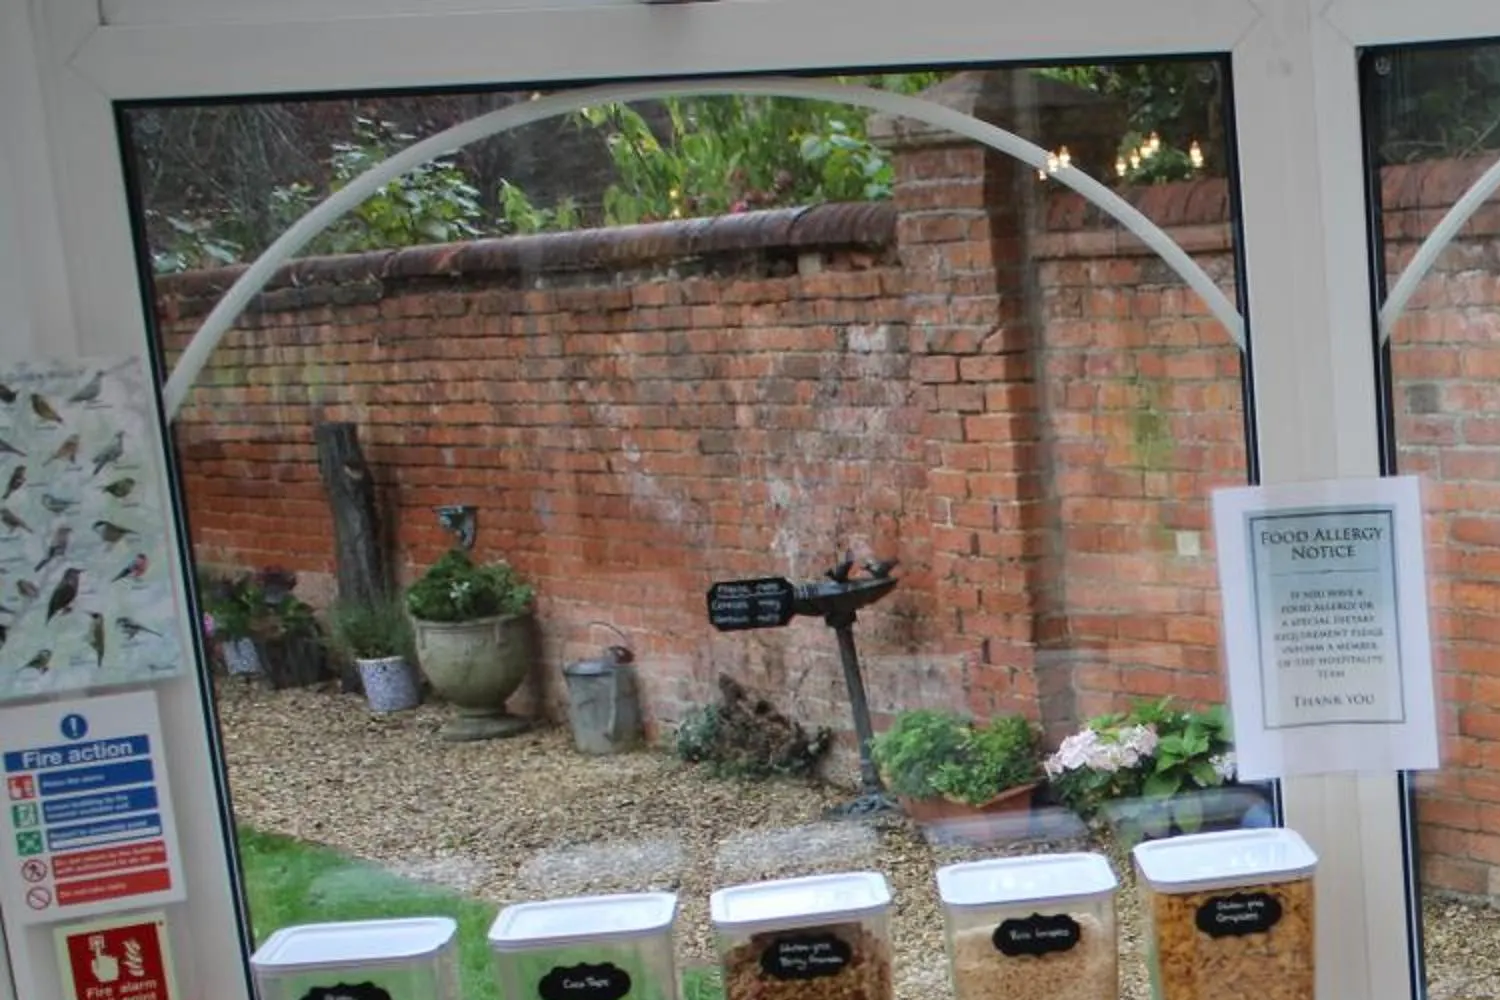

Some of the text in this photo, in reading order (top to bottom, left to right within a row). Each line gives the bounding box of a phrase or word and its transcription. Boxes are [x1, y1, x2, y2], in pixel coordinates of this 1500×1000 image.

[1261, 527, 1383, 545] FOOD ALLERGY
[1291, 545, 1357, 560] NOTICE
[1344, 694, 1375, 705] YOU
[22, 741, 132, 769] Fire action
[86, 979, 158, 999] Fire alarm
